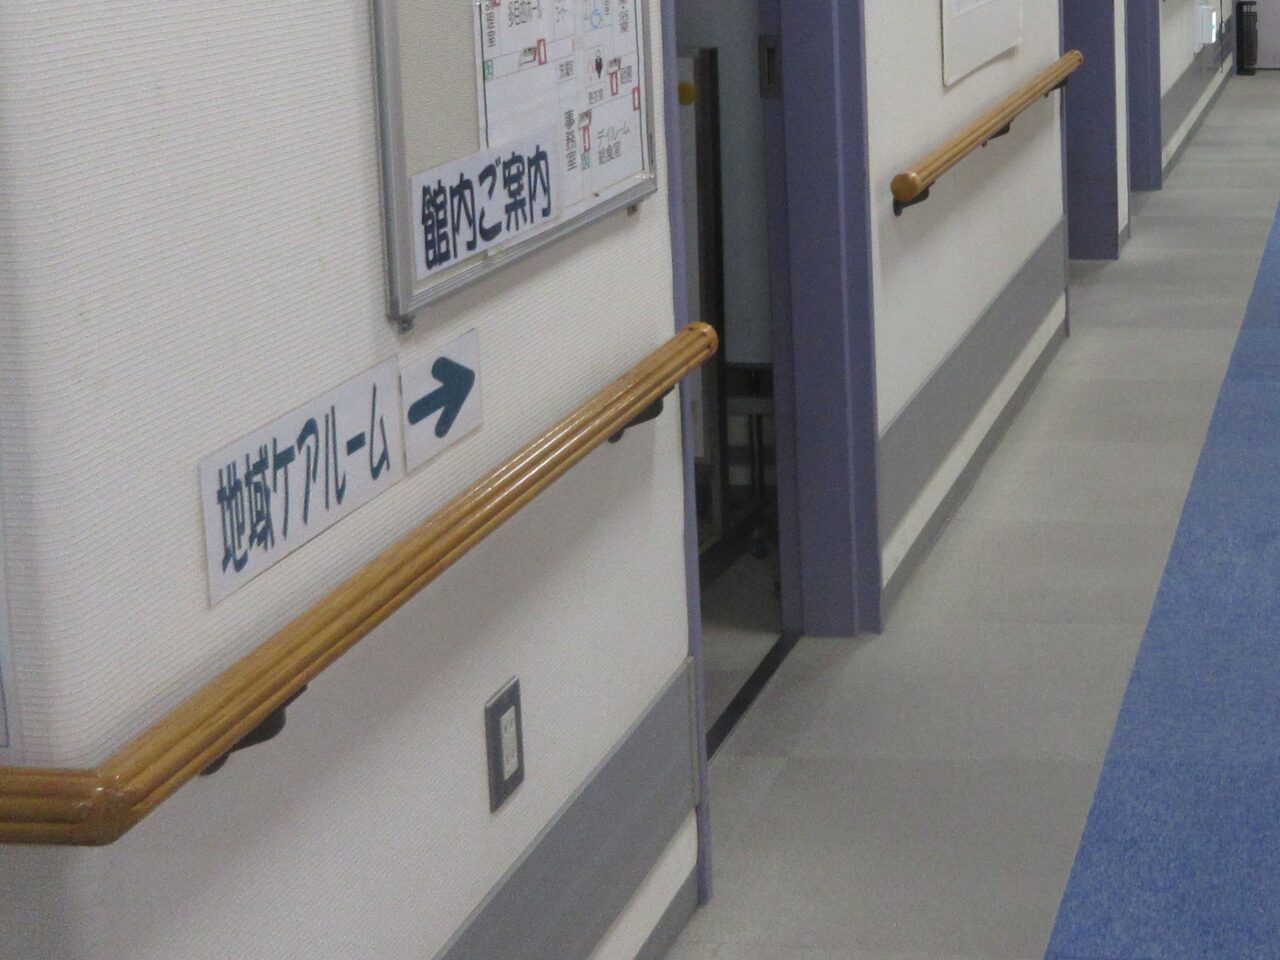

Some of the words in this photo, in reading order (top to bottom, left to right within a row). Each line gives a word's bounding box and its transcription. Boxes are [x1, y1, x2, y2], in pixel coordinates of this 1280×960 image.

[422, 145, 552, 270] 館内ご案内
[217, 383, 390, 574] 地域ケアルーム
